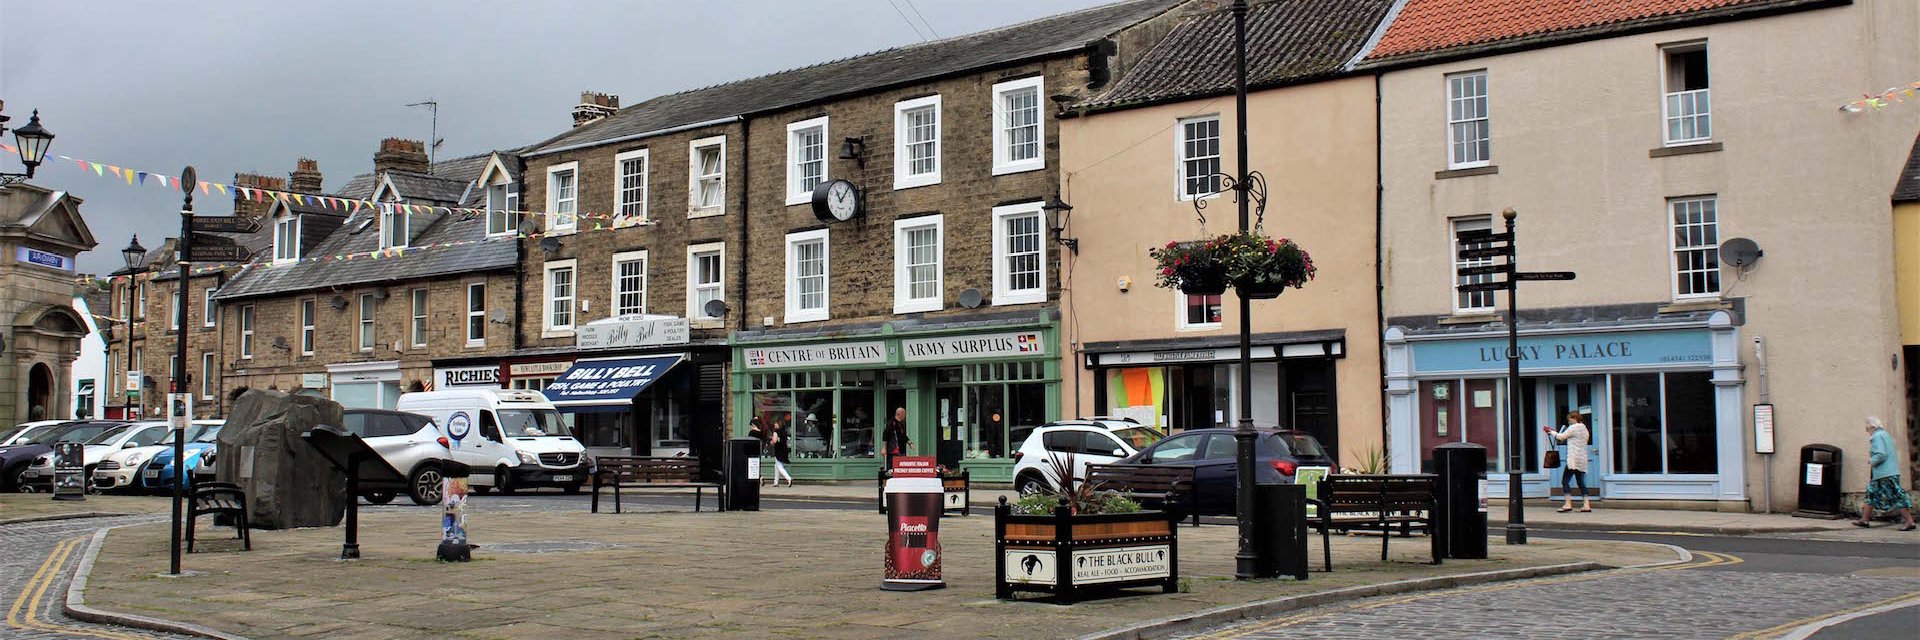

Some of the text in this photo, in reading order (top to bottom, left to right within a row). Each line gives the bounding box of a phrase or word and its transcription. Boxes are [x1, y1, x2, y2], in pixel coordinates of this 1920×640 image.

[606, 322, 655, 346] Billy Bell
[768, 350, 813, 363] CENTRE
[829, 345, 882, 361] BRITAIN
[907, 338, 1014, 357] ARMY SURPLUS
[1556, 341, 1632, 360] PALACE
[543, 363, 563, 372] BOOKSHOP
[567, 365, 656, 380] BILLY BELL
[445, 369, 501, 386] RICHIES
[570, 381, 599, 390] GAME
[607, 379, 651, 389] POULTRY
[900, 522, 927, 532] Piacetto
[1089, 551, 1155, 567] THE BLACK BULL
[1091, 569, 1100, 577] ALE
[1105, 568, 1119, 576] FOOD
